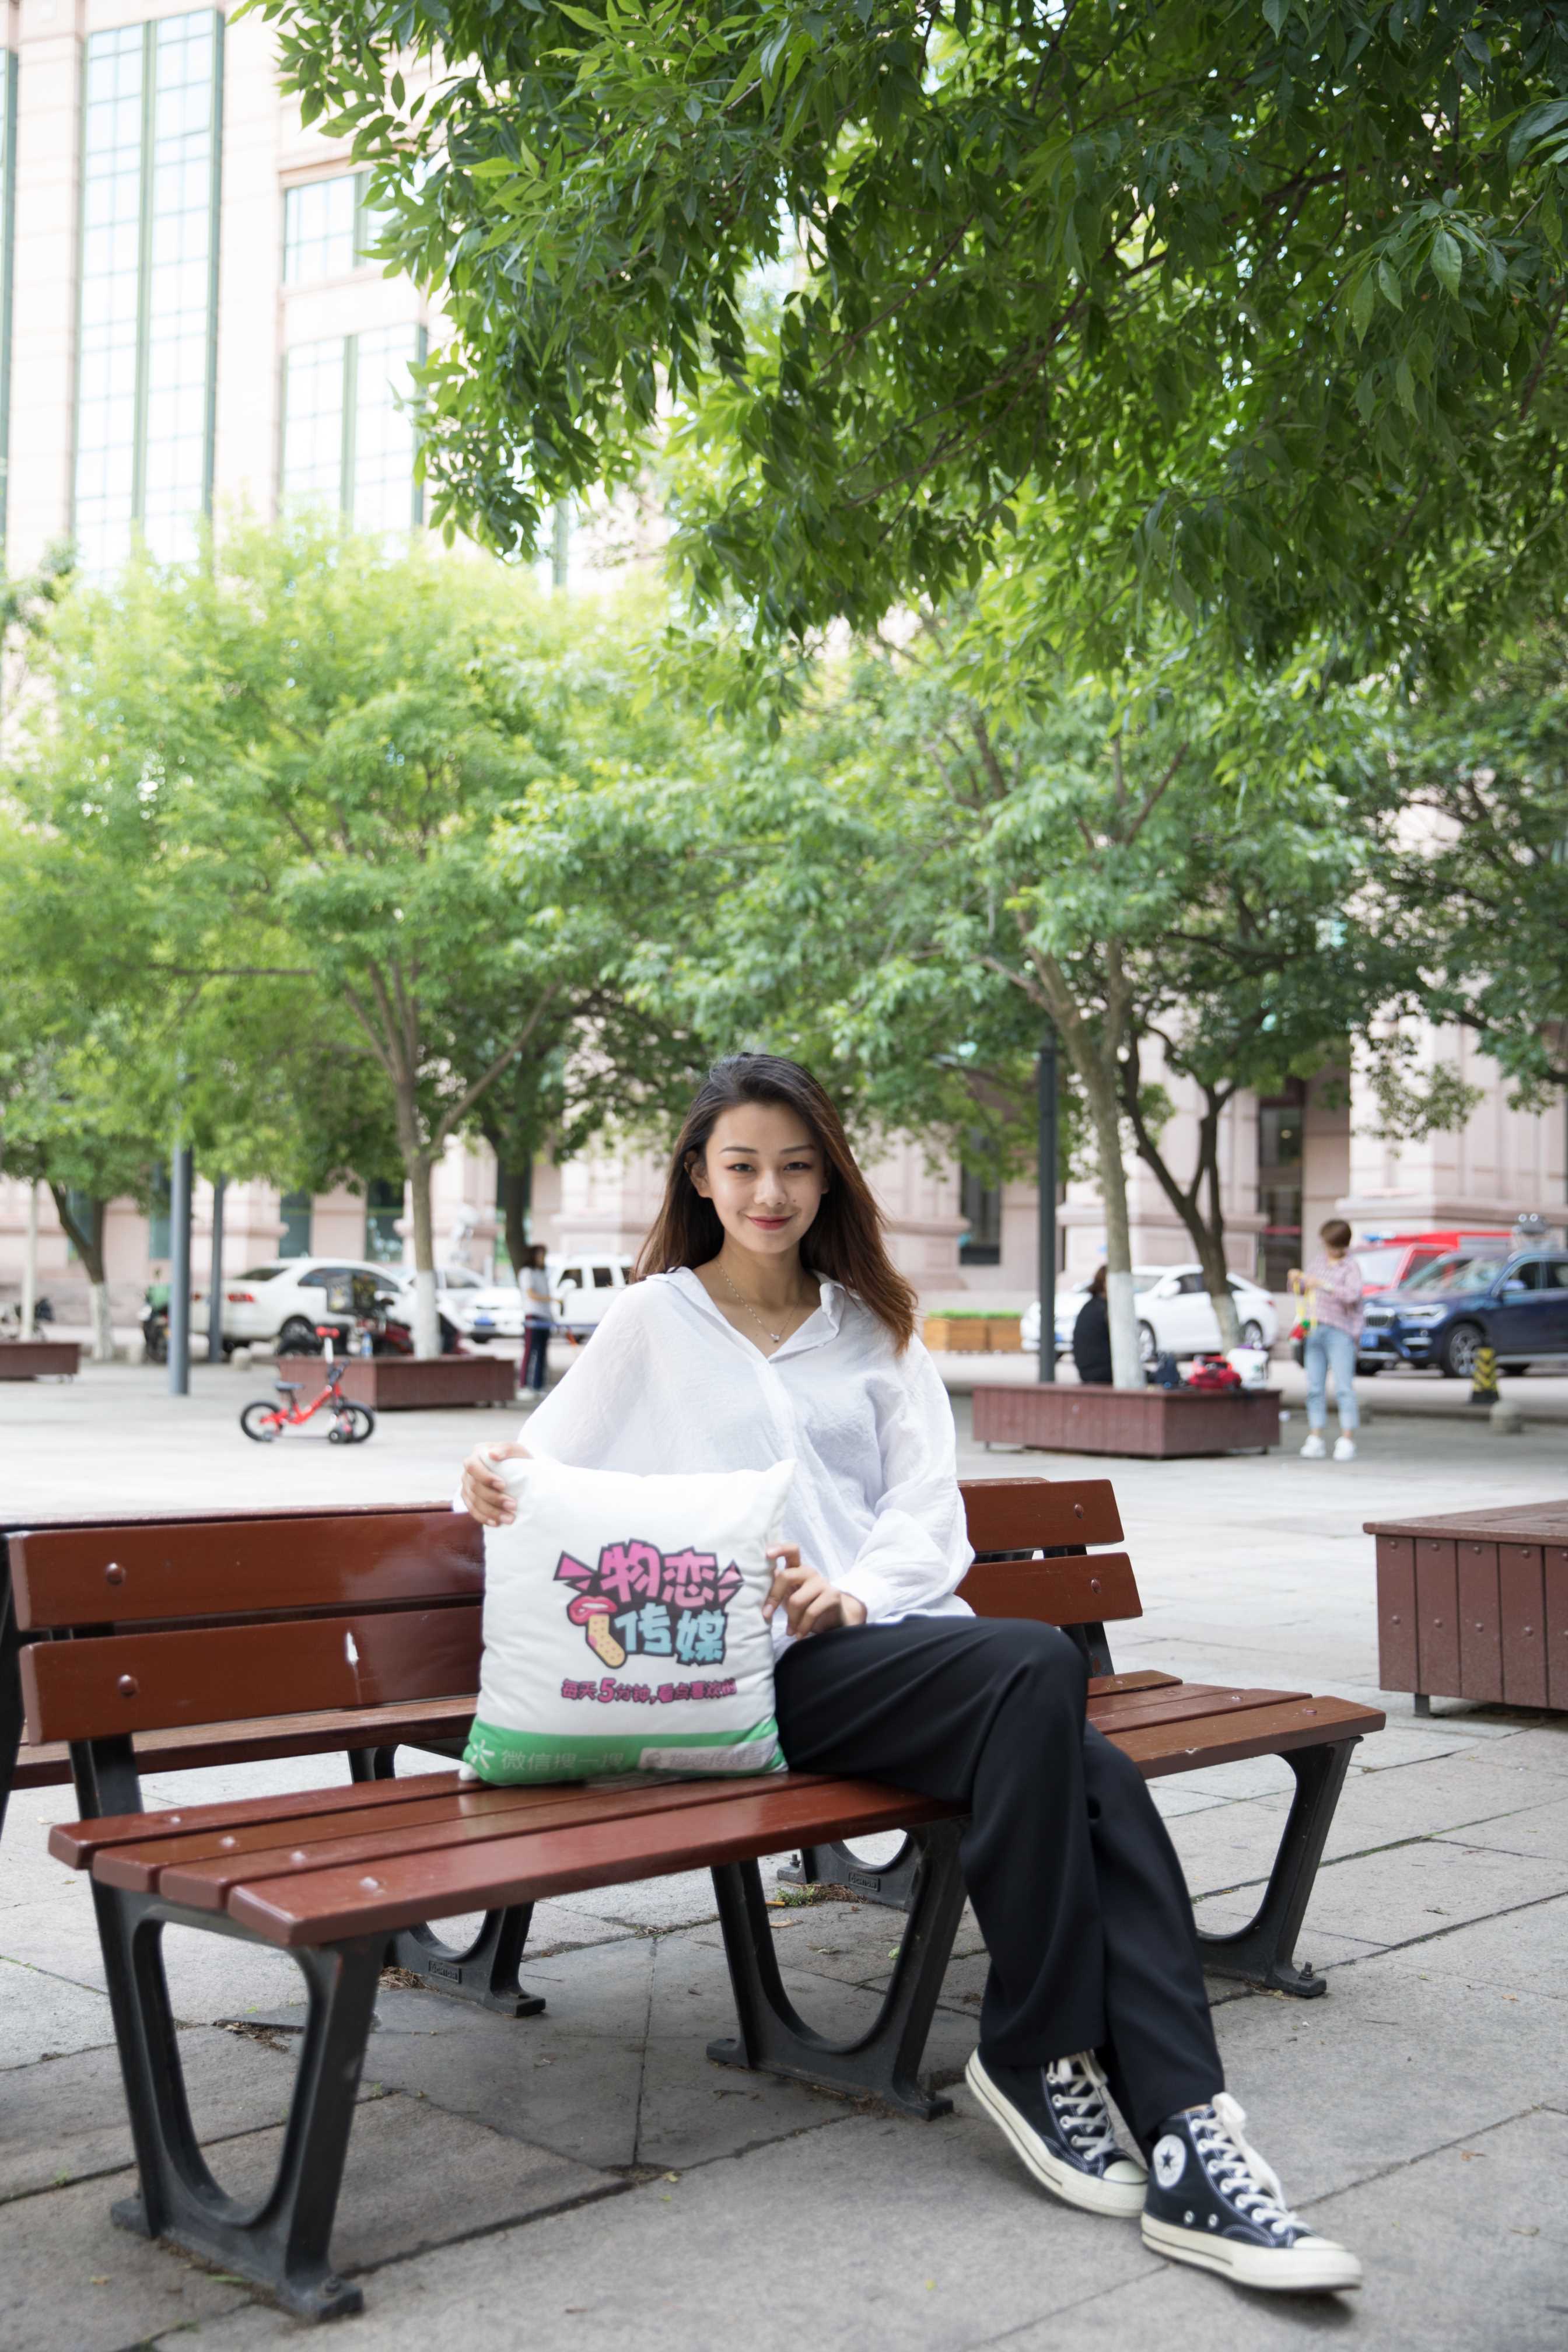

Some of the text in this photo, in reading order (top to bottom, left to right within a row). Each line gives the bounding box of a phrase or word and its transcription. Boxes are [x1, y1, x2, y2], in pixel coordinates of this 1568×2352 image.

[598, 1540, 717, 1608] 物恋
[614, 1602, 726, 1664] 传媒
[502, 1750, 624, 1771] 微信搜一搜
